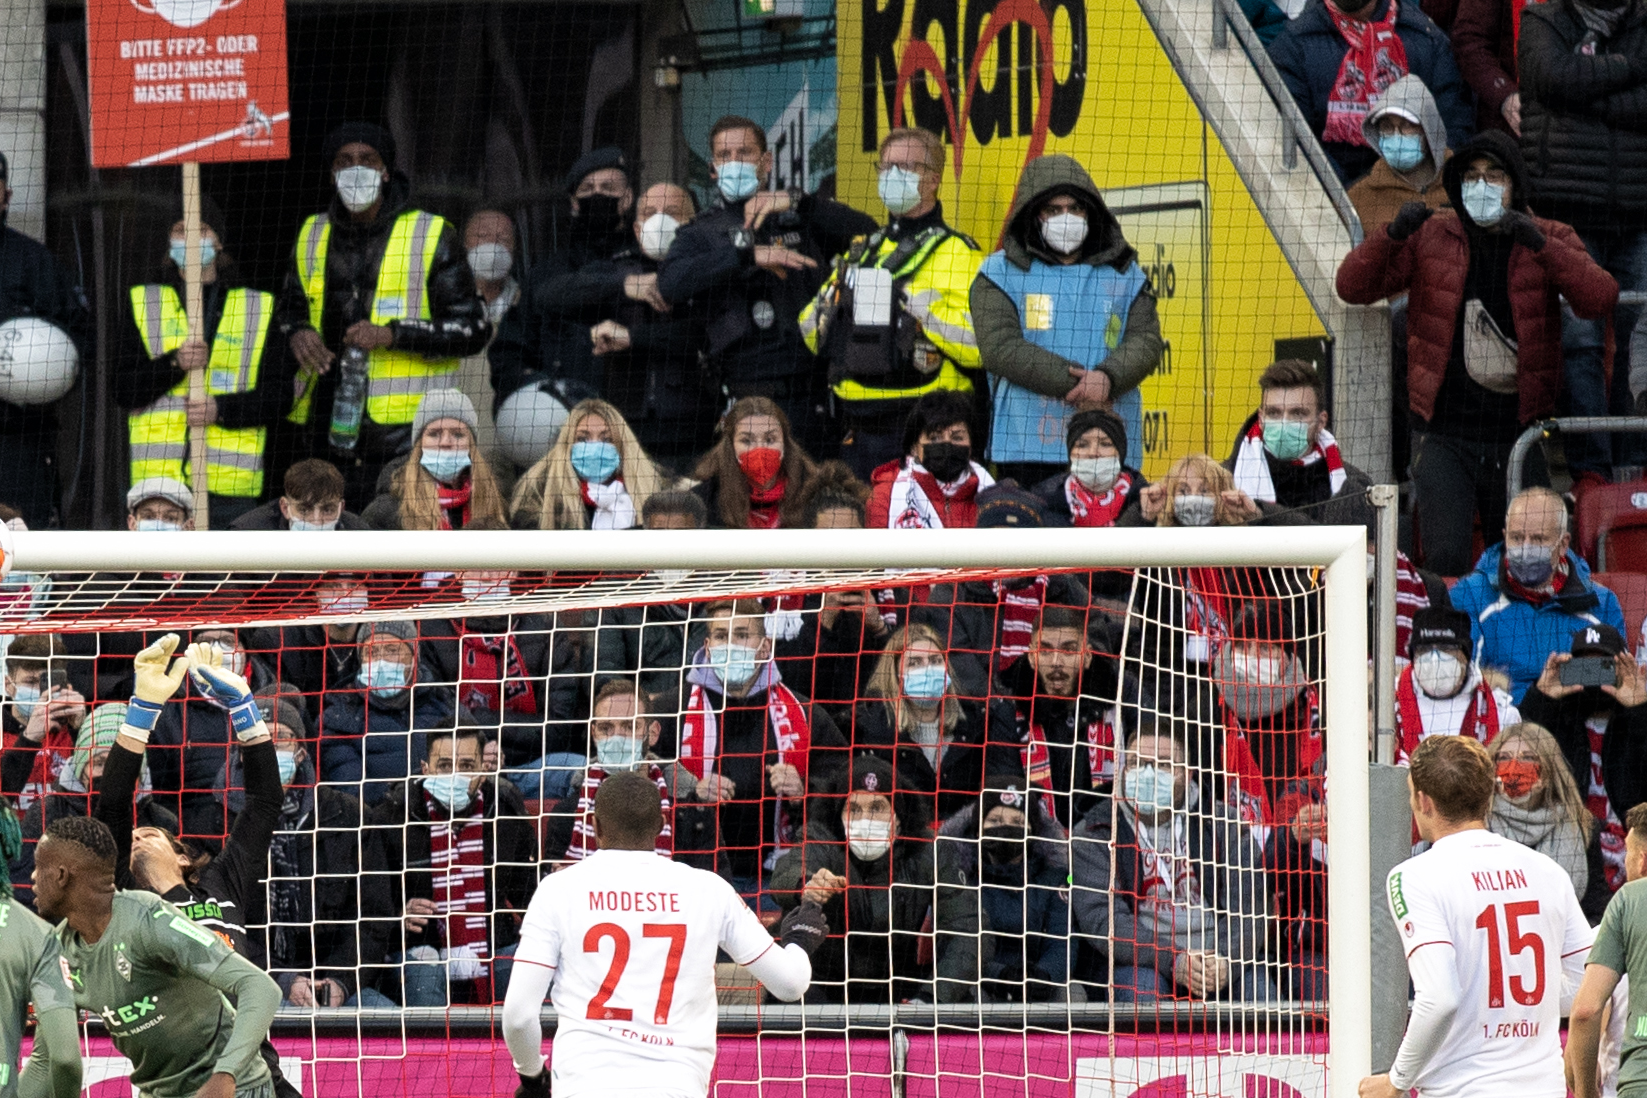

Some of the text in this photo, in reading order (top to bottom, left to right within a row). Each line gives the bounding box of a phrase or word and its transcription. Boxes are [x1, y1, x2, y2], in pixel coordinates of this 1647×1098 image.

[120, 35, 258, 58] BITTE FFP2- ODER
[134, 58, 245, 81] MEDIZINISCHE
[134, 81, 247, 103] MASKE TRAGEN
[1471, 869, 1528, 891] KILIAN
[589, 890, 681, 912] MODESTE
[1390, 876, 1405, 916] DEVK
[1475, 899, 1546, 1008] 15
[583, 922, 687, 1025] 27
[1495, 1023, 1510, 1038] FC
[1512, 1019, 1540, 1038] KÖLN
